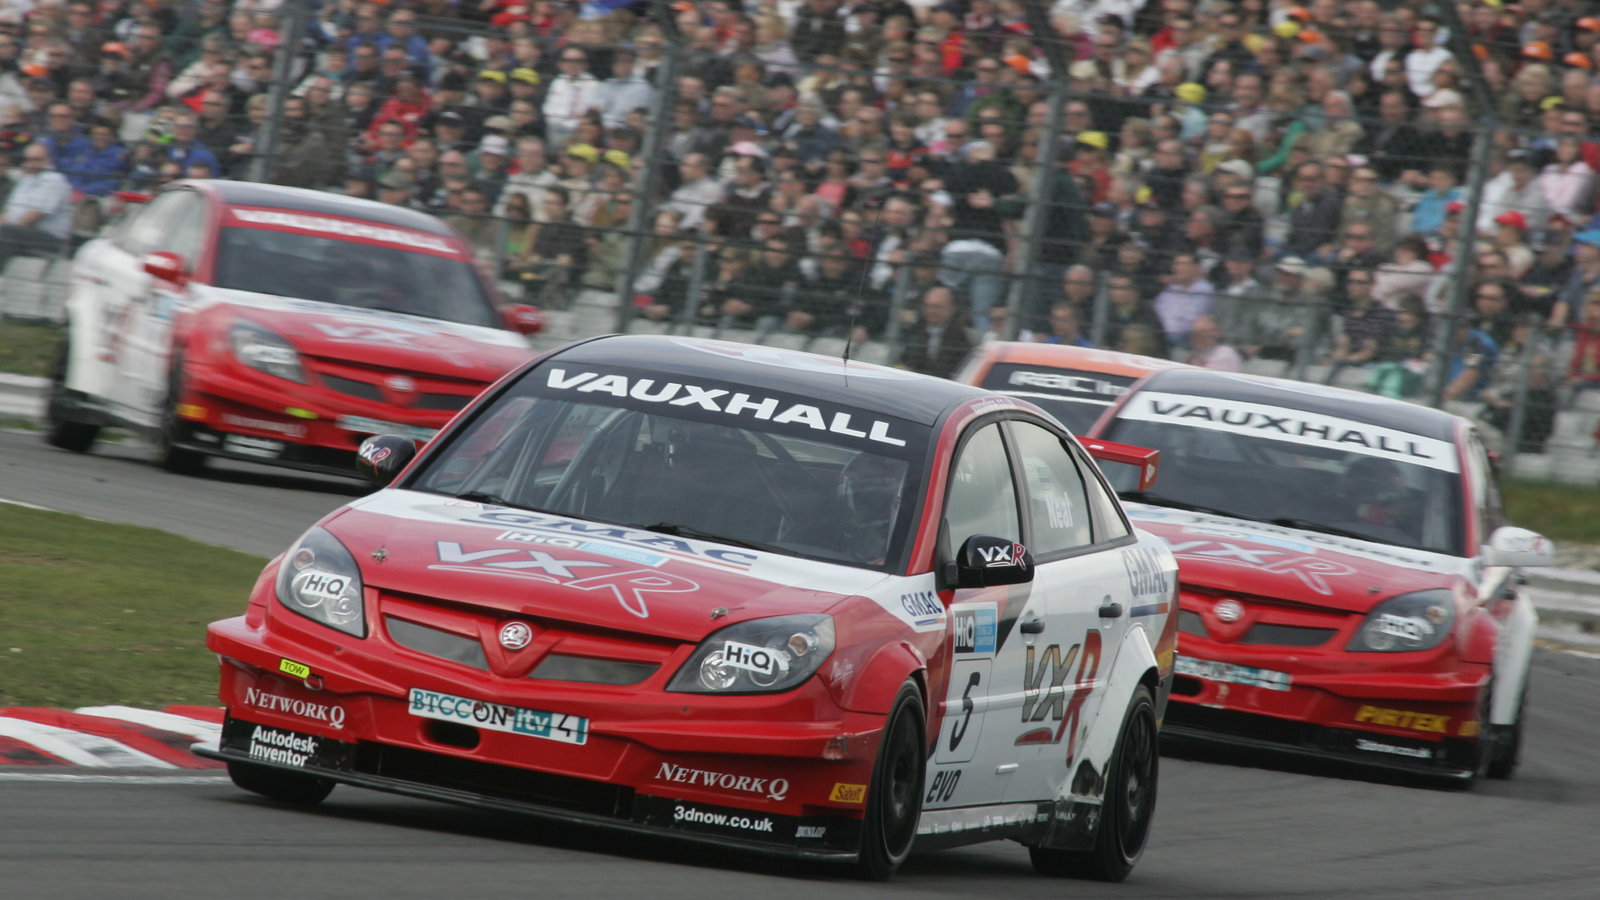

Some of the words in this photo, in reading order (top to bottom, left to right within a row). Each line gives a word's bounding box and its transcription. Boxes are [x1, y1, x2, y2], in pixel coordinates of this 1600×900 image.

[547, 368, 906, 447] VAUXHALL
[1149, 400, 1434, 459] VAUXHALL
[479, 512, 758, 566] GMAC
[506, 531, 581, 549] HiQ
[977, 541, 1026, 570] VXR
[305, 574, 344, 595] HiQ
[435, 541, 700, 618] VXR
[1121, 546, 1168, 597] GMAC
[901, 591, 943, 617] GMAC
[955, 616, 975, 648] HiQ
[283, 661, 306, 675] TOW
[725, 645, 771, 670] HiQ
[244, 687, 330, 721] NETWORK
[330, 705, 345, 729] Q
[949, 671, 981, 752] 5
[1021, 628, 1102, 768] VXR
[516, 708, 550, 732] itv
[557, 714, 571, 737] 4
[1354, 705, 1452, 733] PIRTEK
[249, 740, 309, 767] Inventor
[252, 725, 316, 754] Autodesk
[655, 762, 768, 793] NETWORK
[767, 778, 789, 800] Q
[926, 769, 962, 803] evo
[673, 805, 774, 832] 3dnow.co.uk
[795, 825, 826, 838] DUNLOP
